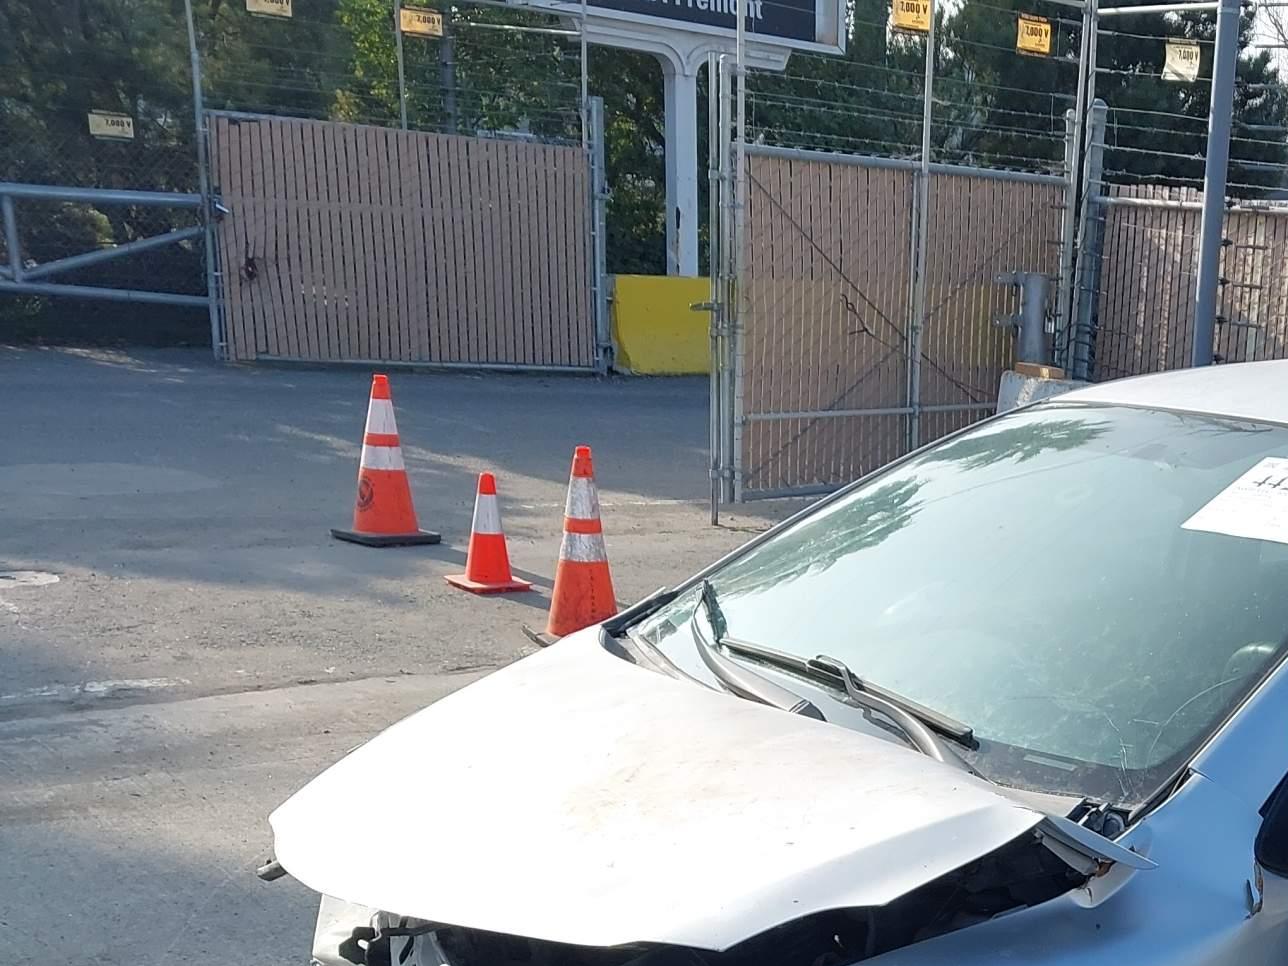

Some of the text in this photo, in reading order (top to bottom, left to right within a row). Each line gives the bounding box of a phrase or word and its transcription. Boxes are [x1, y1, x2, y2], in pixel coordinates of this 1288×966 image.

[900, 1, 928, 15] 7,000 V
[1044, 29, 1050, 38] V
[1194, 51, 1199, 61] V
